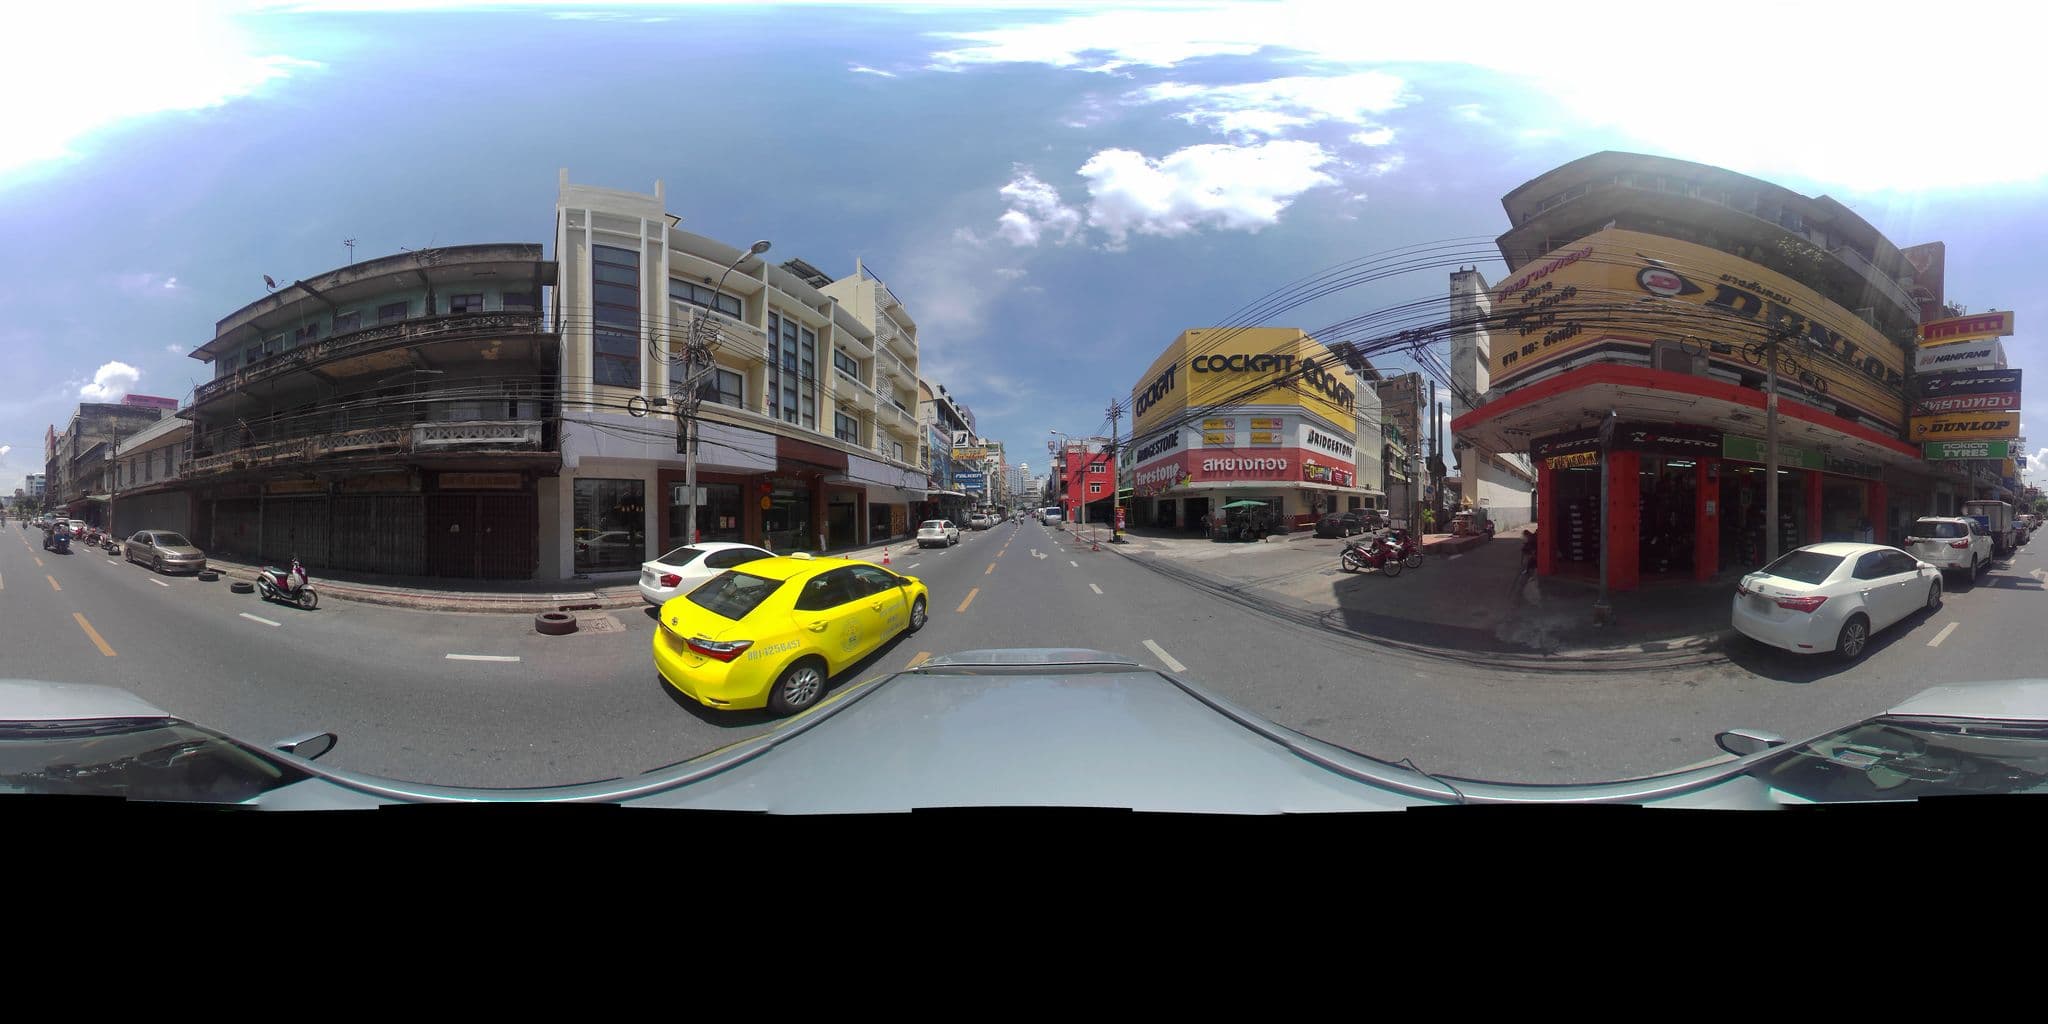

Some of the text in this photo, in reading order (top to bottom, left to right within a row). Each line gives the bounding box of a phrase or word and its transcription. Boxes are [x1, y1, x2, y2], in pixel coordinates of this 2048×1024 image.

[1192, 354, 1295, 373] COCKPIT
[1935, 350, 1991, 364] NANKANG
[1302, 357, 1355, 413] COCKPIT
[1951, 377, 2016, 386] NITTO
[1136, 364, 1177, 417] COCKPIT
[1930, 421, 2010, 433] DUNLOP
[1137, 430, 1180, 463] BRIDGESTONE
[1307, 429, 1353, 458] BRIDGESTONE
[1657, 436, 1718, 447] NITTO
[1944, 449, 1988, 457] TYRES
[1203, 458, 1288, 471] สหยางทอง
